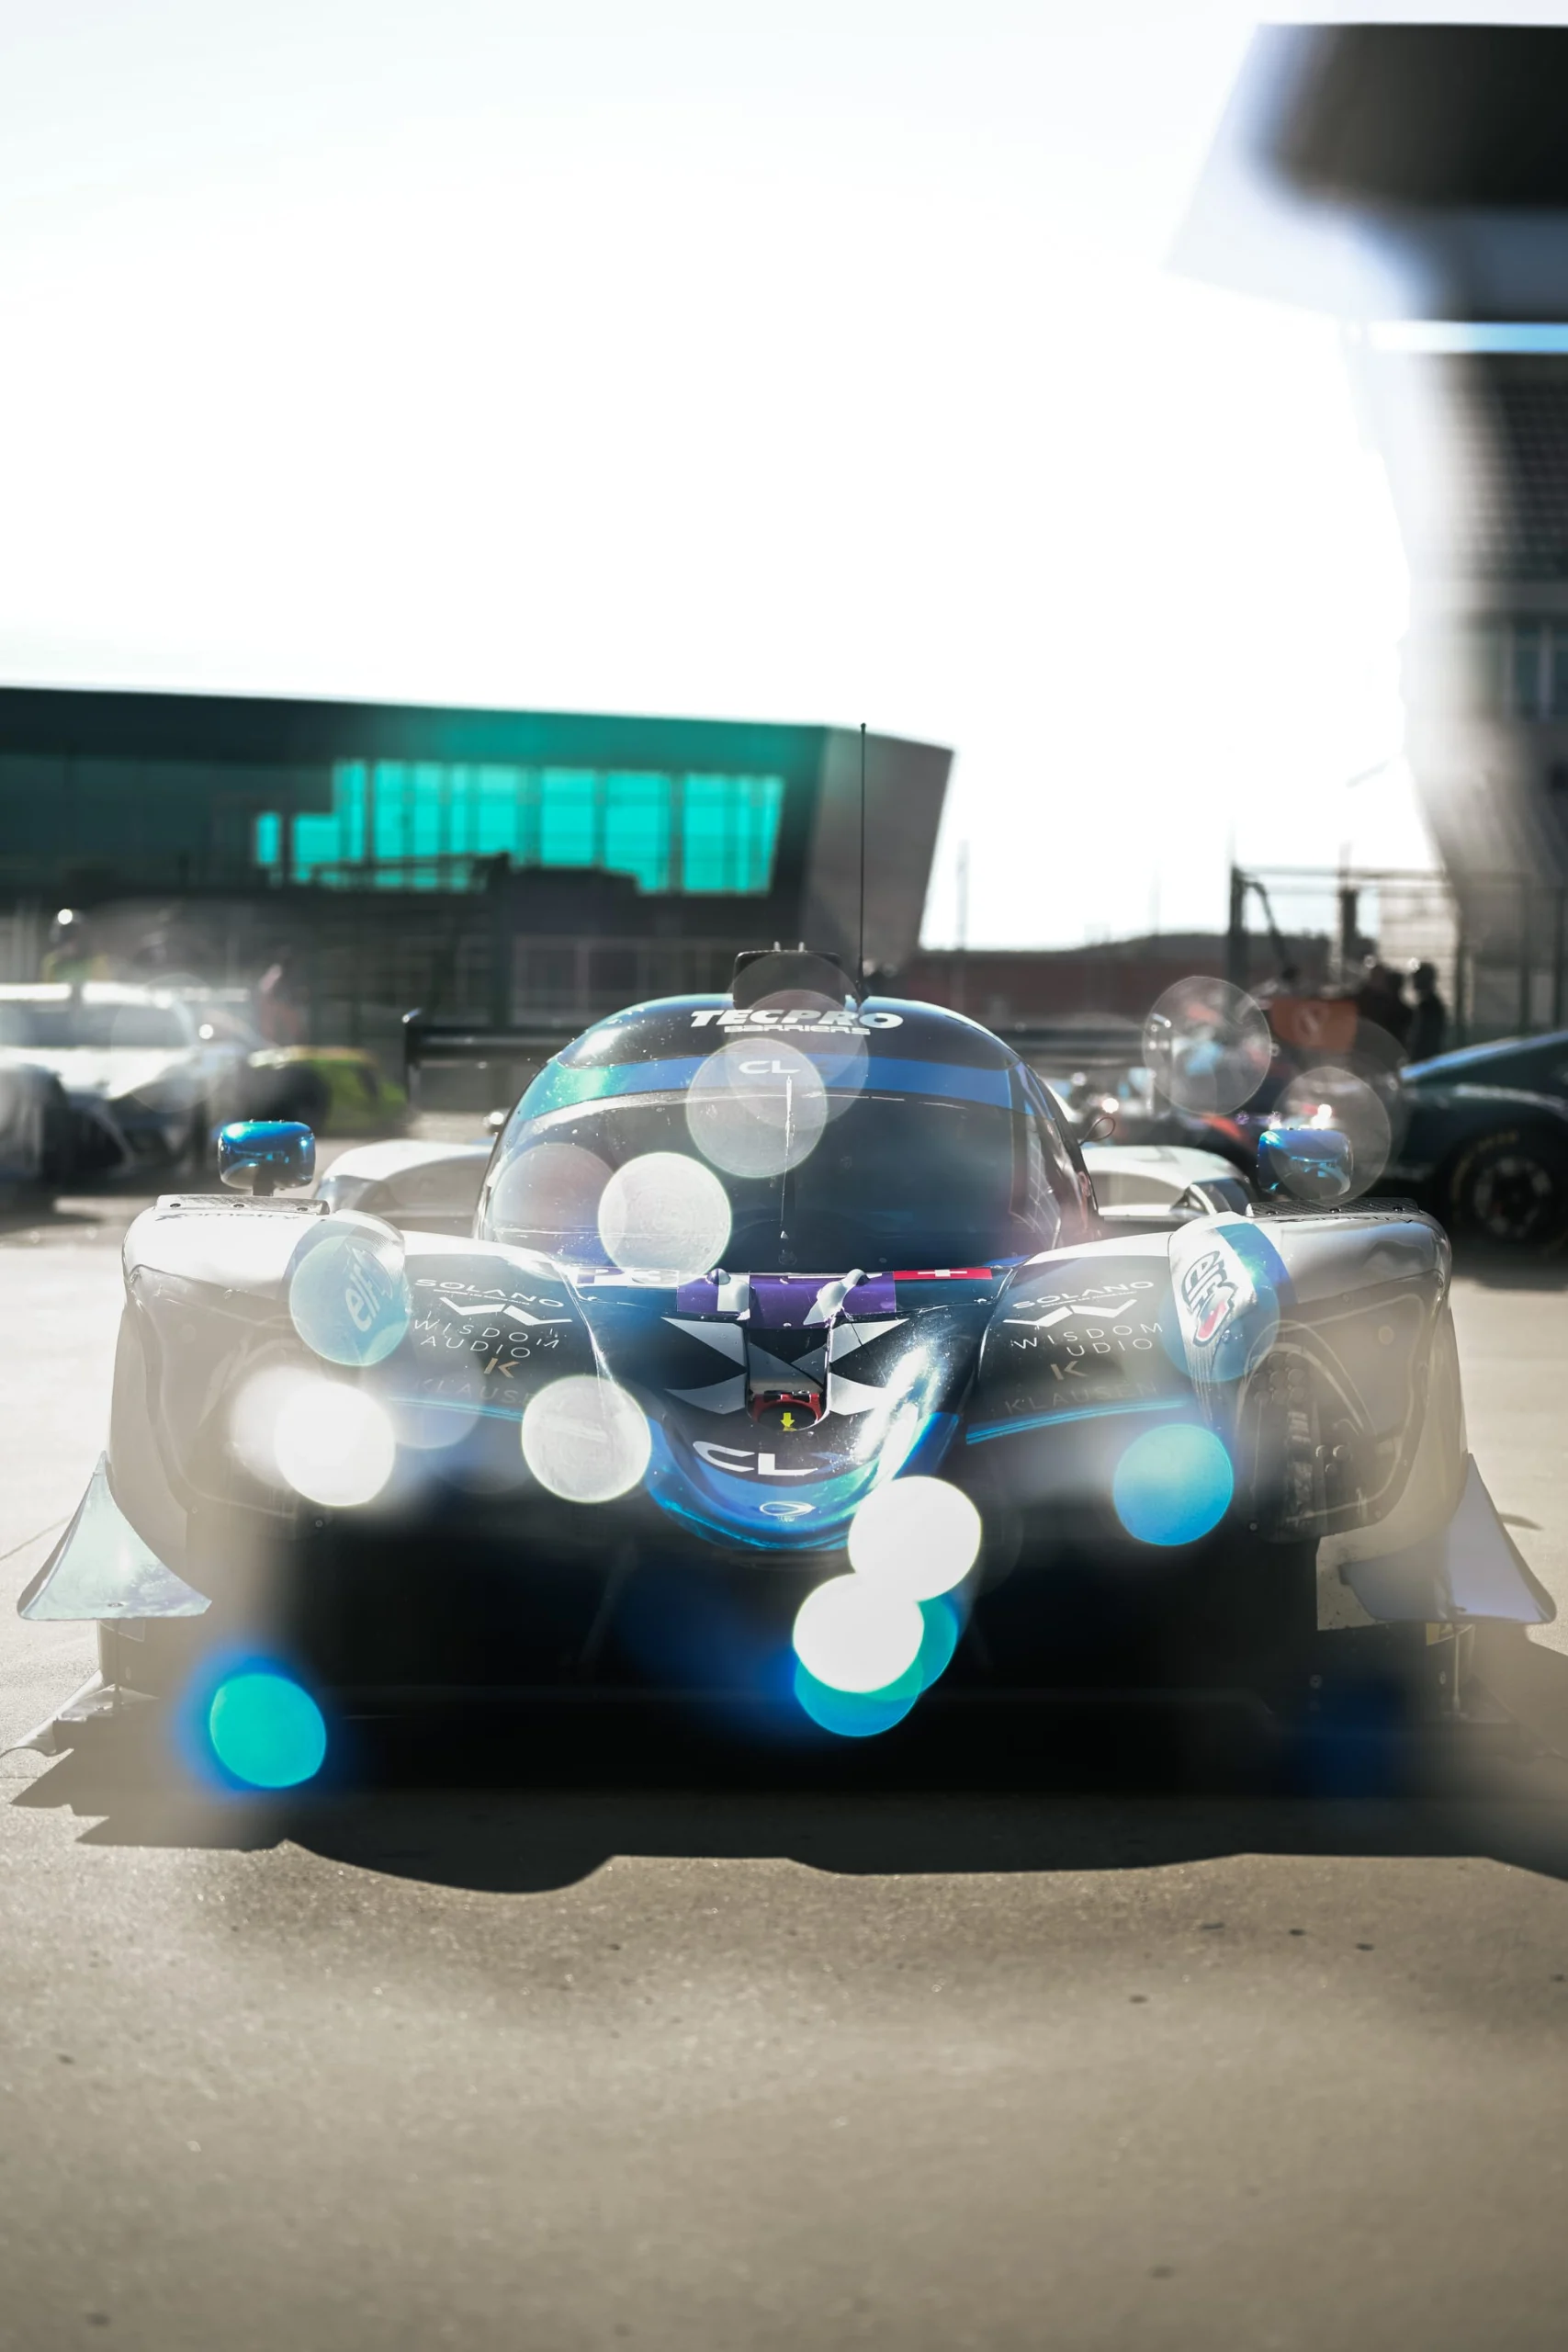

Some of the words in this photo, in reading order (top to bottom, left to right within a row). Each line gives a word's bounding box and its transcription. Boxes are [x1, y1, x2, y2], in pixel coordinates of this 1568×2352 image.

[691, 1010, 904, 1028] TECPRO
[345, 1262, 381, 1332] elf
[415, 1279, 564, 1307] SOLANO
[1012, 1282, 1154, 1309] SOLANO
[421, 1336, 530, 1358] AUDIO
[1012, 1322, 1163, 1350] WISDOM
[1005, 1381, 1158, 1415] KLAUSEN
